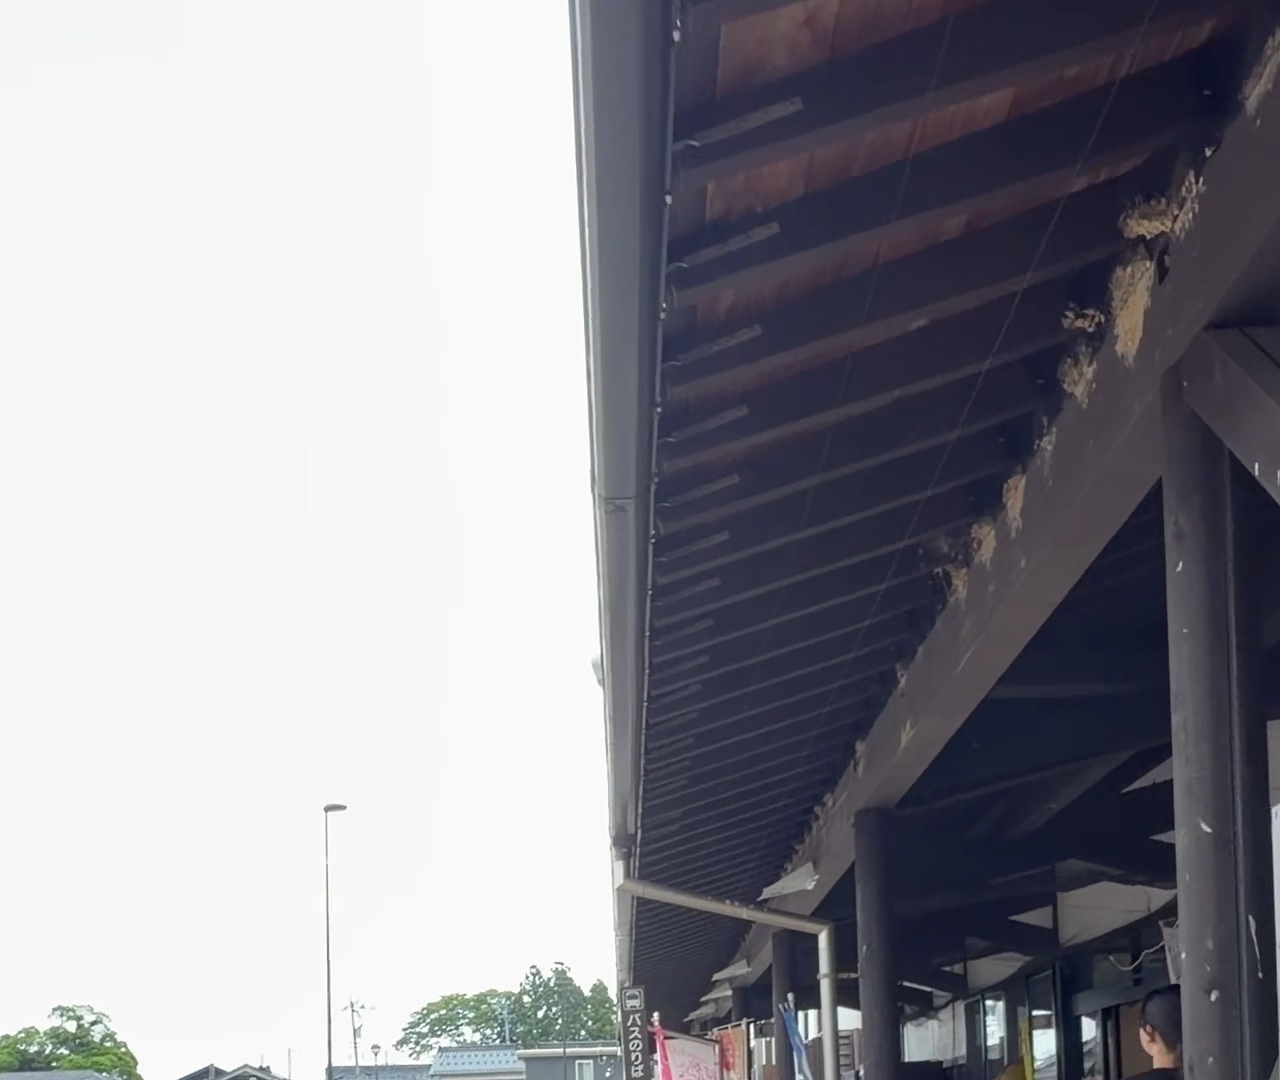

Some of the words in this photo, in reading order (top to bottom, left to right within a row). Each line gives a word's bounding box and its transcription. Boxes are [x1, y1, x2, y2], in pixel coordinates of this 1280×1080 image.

[627, 1013, 644, 1078] バスのりば
